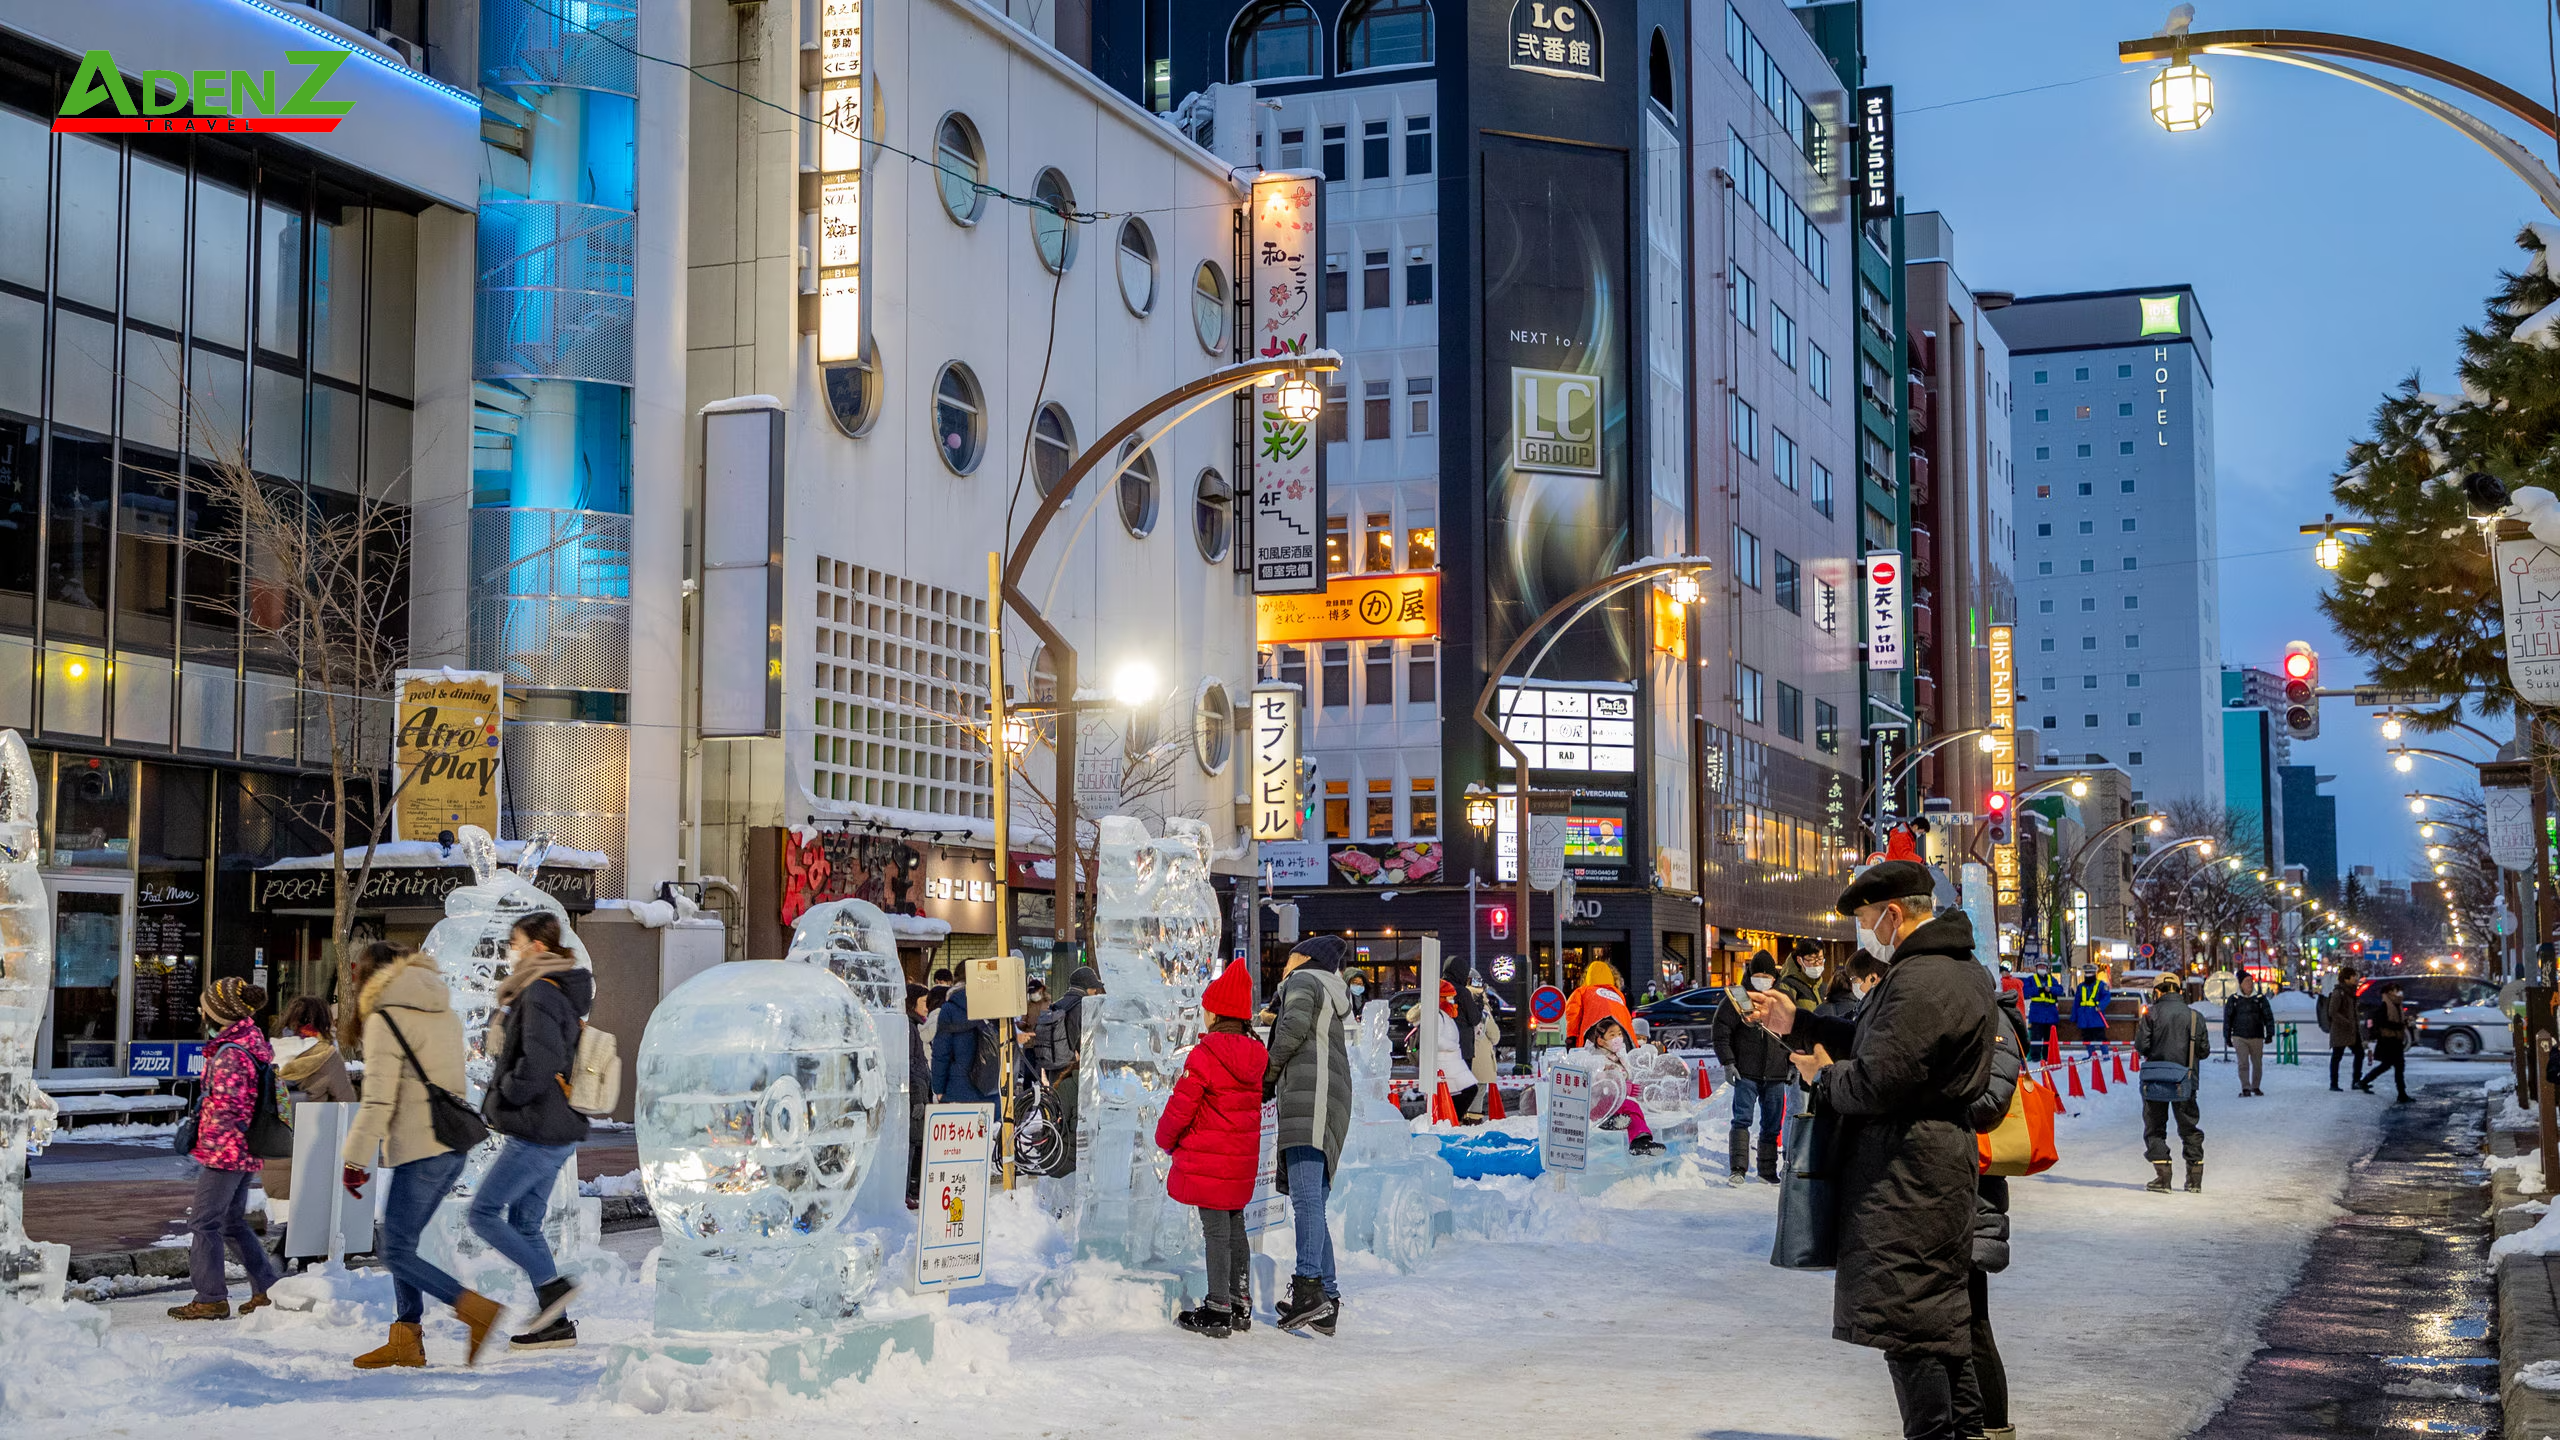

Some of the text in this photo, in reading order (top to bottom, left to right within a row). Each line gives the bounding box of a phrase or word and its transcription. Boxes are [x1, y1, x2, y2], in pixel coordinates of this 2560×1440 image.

[1532, 3, 1575, 32] LC
[1517, 33, 1590, 66] 弐番館
[825, 60, 859, 73] くに子
[837, 81, 847, 89] 2F
[823, 96, 860, 134] 橘
[1867, 97, 1885, 207] さいとうビル
[837, 174, 847, 182] 1F
[835, 269, 846, 277] B1
[1262, 241, 1308, 314] 和ごころ
[2149, 304, 2171, 316] ibis
[1510, 329, 1570, 347] NEXT to
[2155, 347, 2168, 446] HOTEL
[1525, 378, 1592, 442] LC
[1525, 442, 1593, 466] GROUP
[1259, 493, 1281, 506] 4F
[1258, 546, 1313, 560] 和風居酒屋
[1262, 564, 1309, 578] 個室完備
[1328, 609, 1350, 621] 博多
[1874, 587, 1896, 653] 天下一品
[2525, 665, 2554, 677] Suki
[409, 688, 491, 704] pool & dining
[1992, 641, 2012, 786] ティアラホテル
[396, 707, 475, 748] Afro
[1877, 731, 1899, 741] 3F
[1559, 751, 1574, 760] RAD
[1260, 698, 1289, 833] セブンビル
[420, 753, 500, 797] Play
[1573, 900, 1602, 918] AD
[132, 1057, 170, 1071] アクエリアス
[1556, 1073, 1579, 1088] 自動車
[933, 1121, 974, 1142] onちゃん
[942, 1186, 951, 1211] 6
[945, 1222, 964, 1239] HTB
